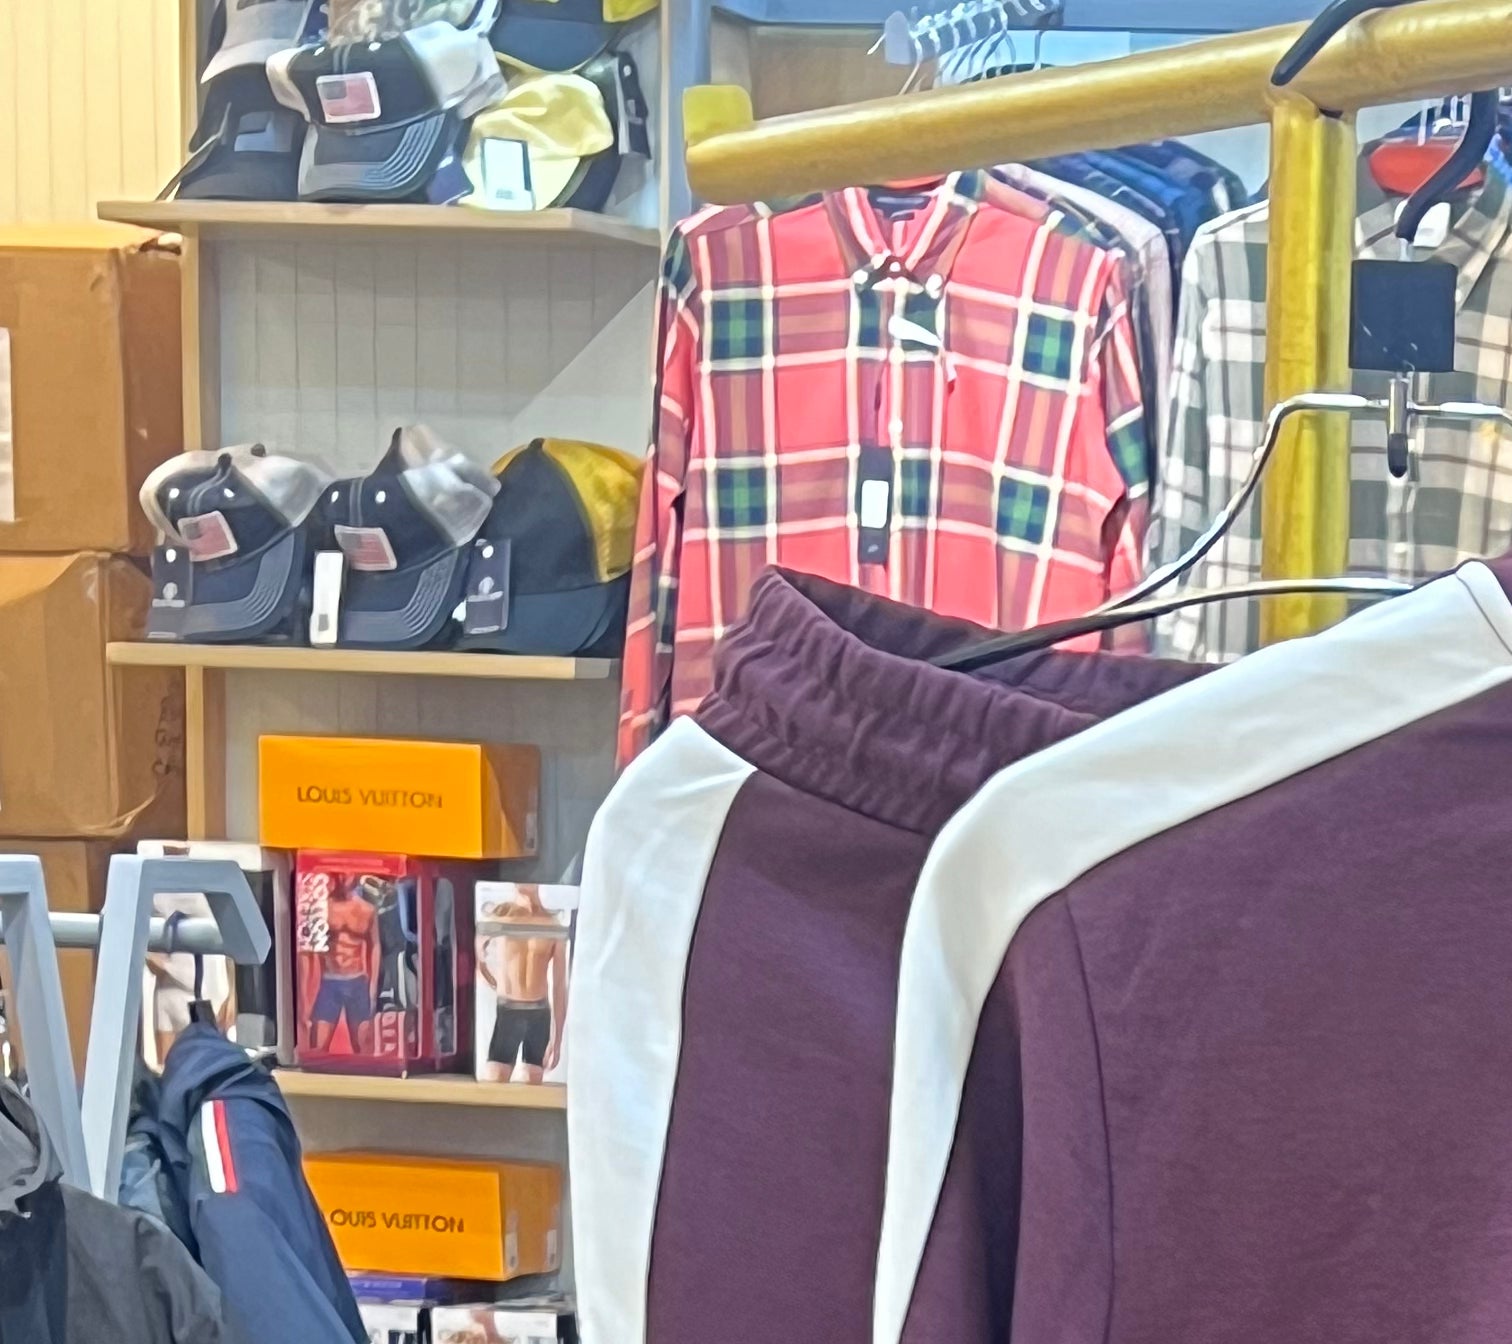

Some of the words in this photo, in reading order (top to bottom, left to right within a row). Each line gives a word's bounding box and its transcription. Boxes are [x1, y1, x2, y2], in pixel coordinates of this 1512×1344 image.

[296, 785, 352, 805] LOUIS
[358, 790, 443, 810] VUITTON
[330, 1209, 377, 1228] OUIS
[381, 1211, 465, 1233] VUITTON
